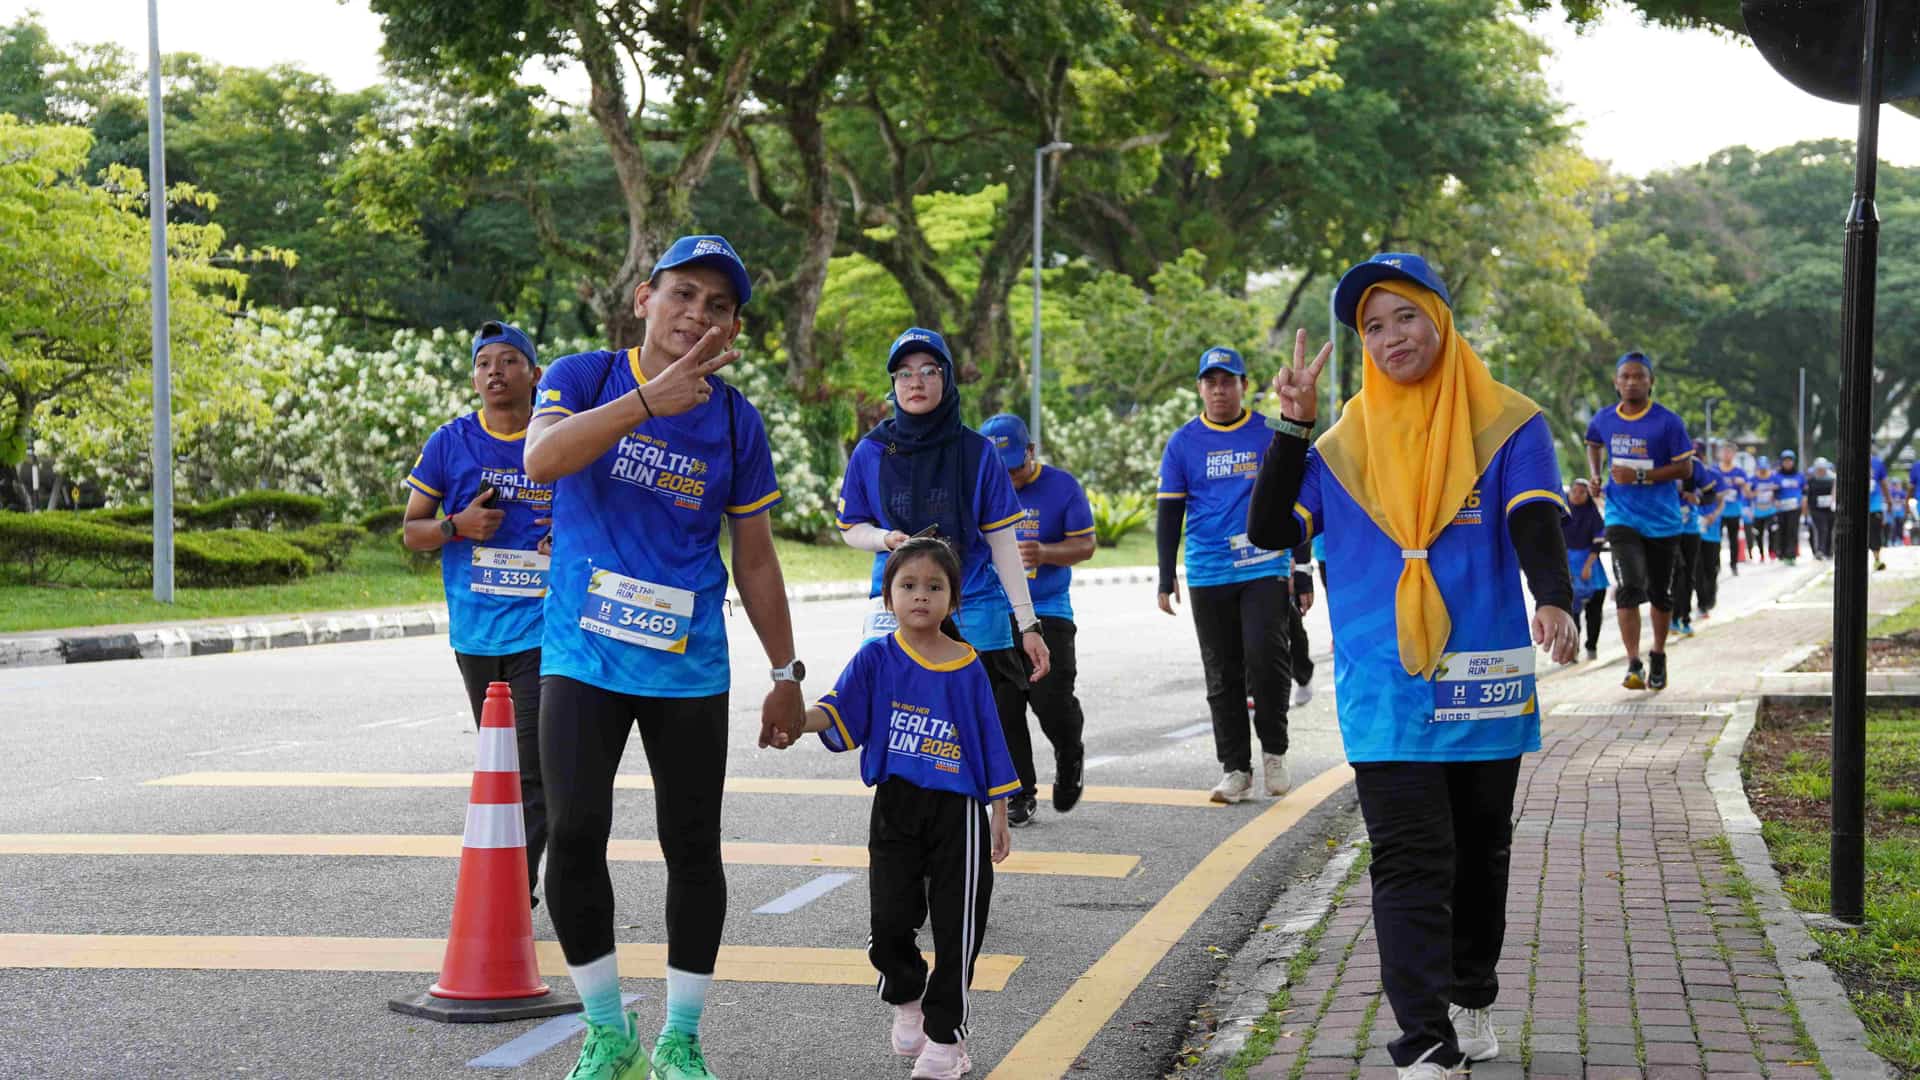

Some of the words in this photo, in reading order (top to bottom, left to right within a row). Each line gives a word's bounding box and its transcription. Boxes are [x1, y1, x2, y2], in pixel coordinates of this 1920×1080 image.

[618, 436, 697, 475] HEALTH
[1206, 452, 1248, 466] HEALTH
[611, 457, 656, 486] RUN
[656, 471, 706, 496] 2026
[1207, 464, 1231, 478] RUN
[517, 489, 552, 501] 2026
[484, 569, 492, 578] H
[499, 571, 542, 585] 3394
[616, 589, 634, 599] RUN
[618, 581, 650, 595] HEALTH
[600, 601, 612, 614] H
[619, 606, 677, 635] 3469
[1469, 657, 1498, 666] HEALTH
[1467, 666, 1487, 675] RUN
[1454, 685, 1466, 697] H
[1480, 680, 1522, 703] 3971
[888, 730, 920, 753] UN
[920, 737, 960, 760] 2026
